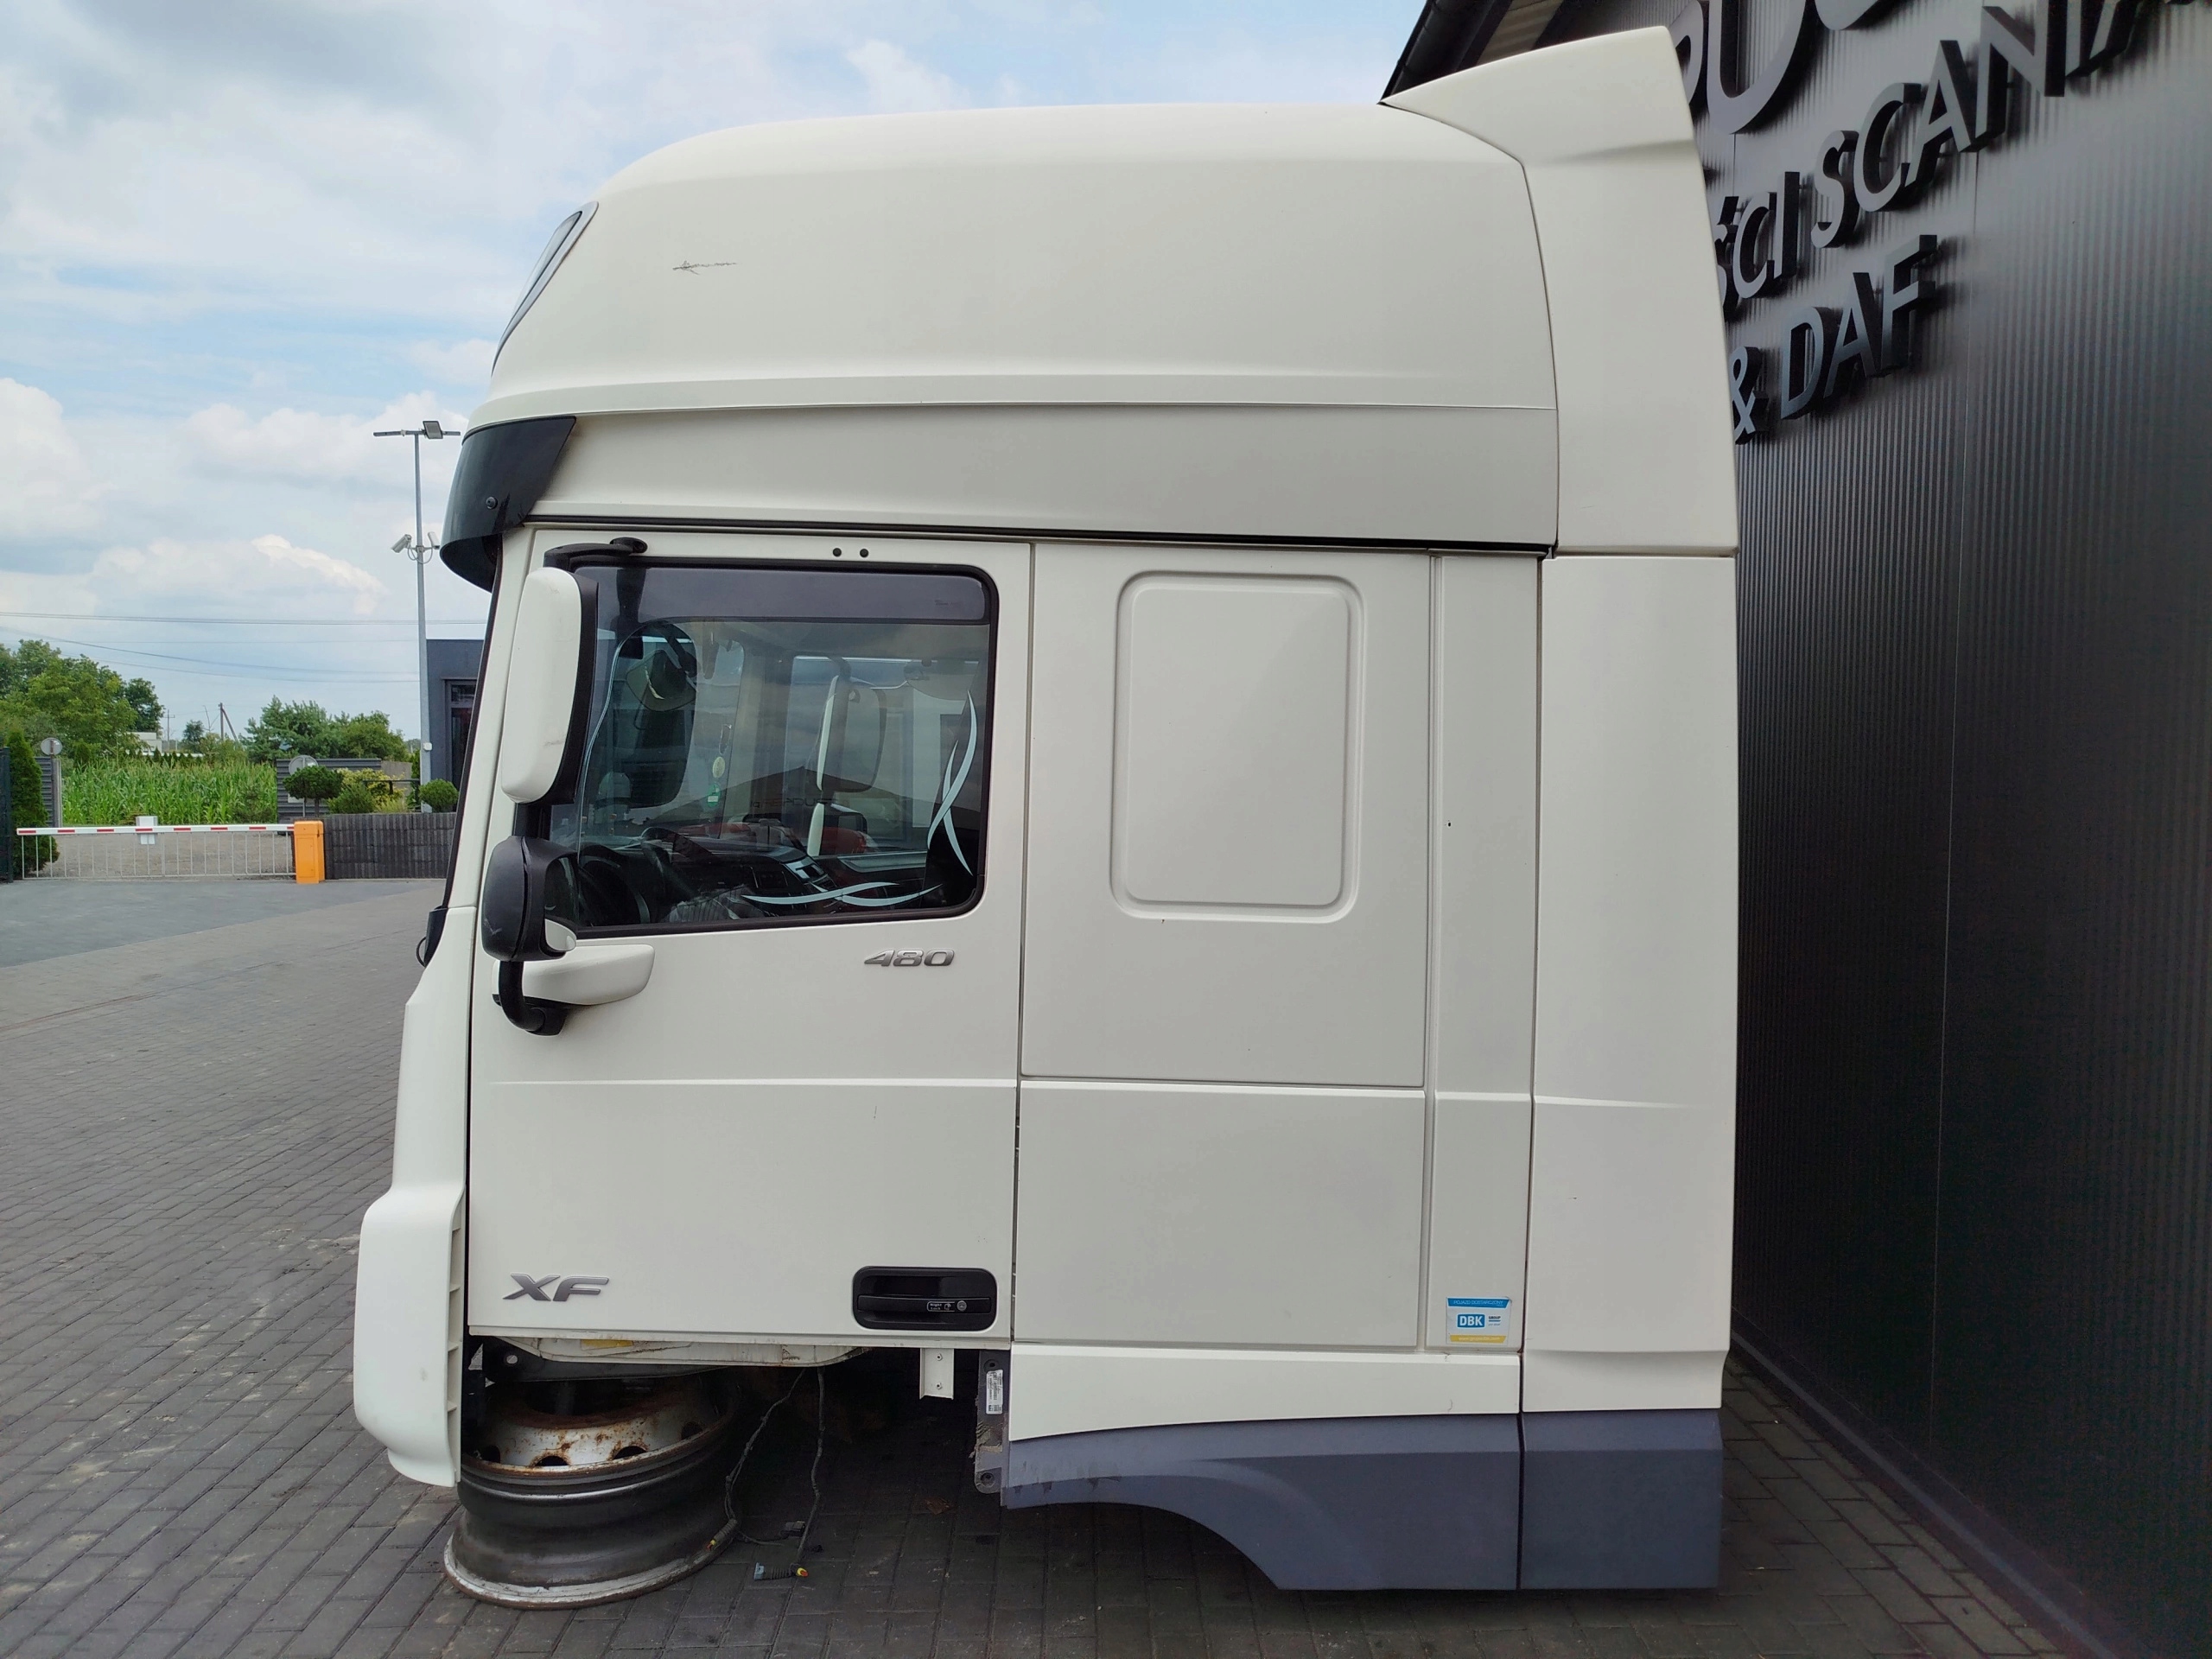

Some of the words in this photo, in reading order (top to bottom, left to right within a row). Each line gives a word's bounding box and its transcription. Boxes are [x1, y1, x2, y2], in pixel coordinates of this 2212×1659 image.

[1729, 346, 1769, 444] &
[1781, 234, 1937, 419] DAF
[864, 950, 955, 967] 480
[502, 1273, 609, 1301] XF
[1459, 1316, 1483, 1325] DBK
